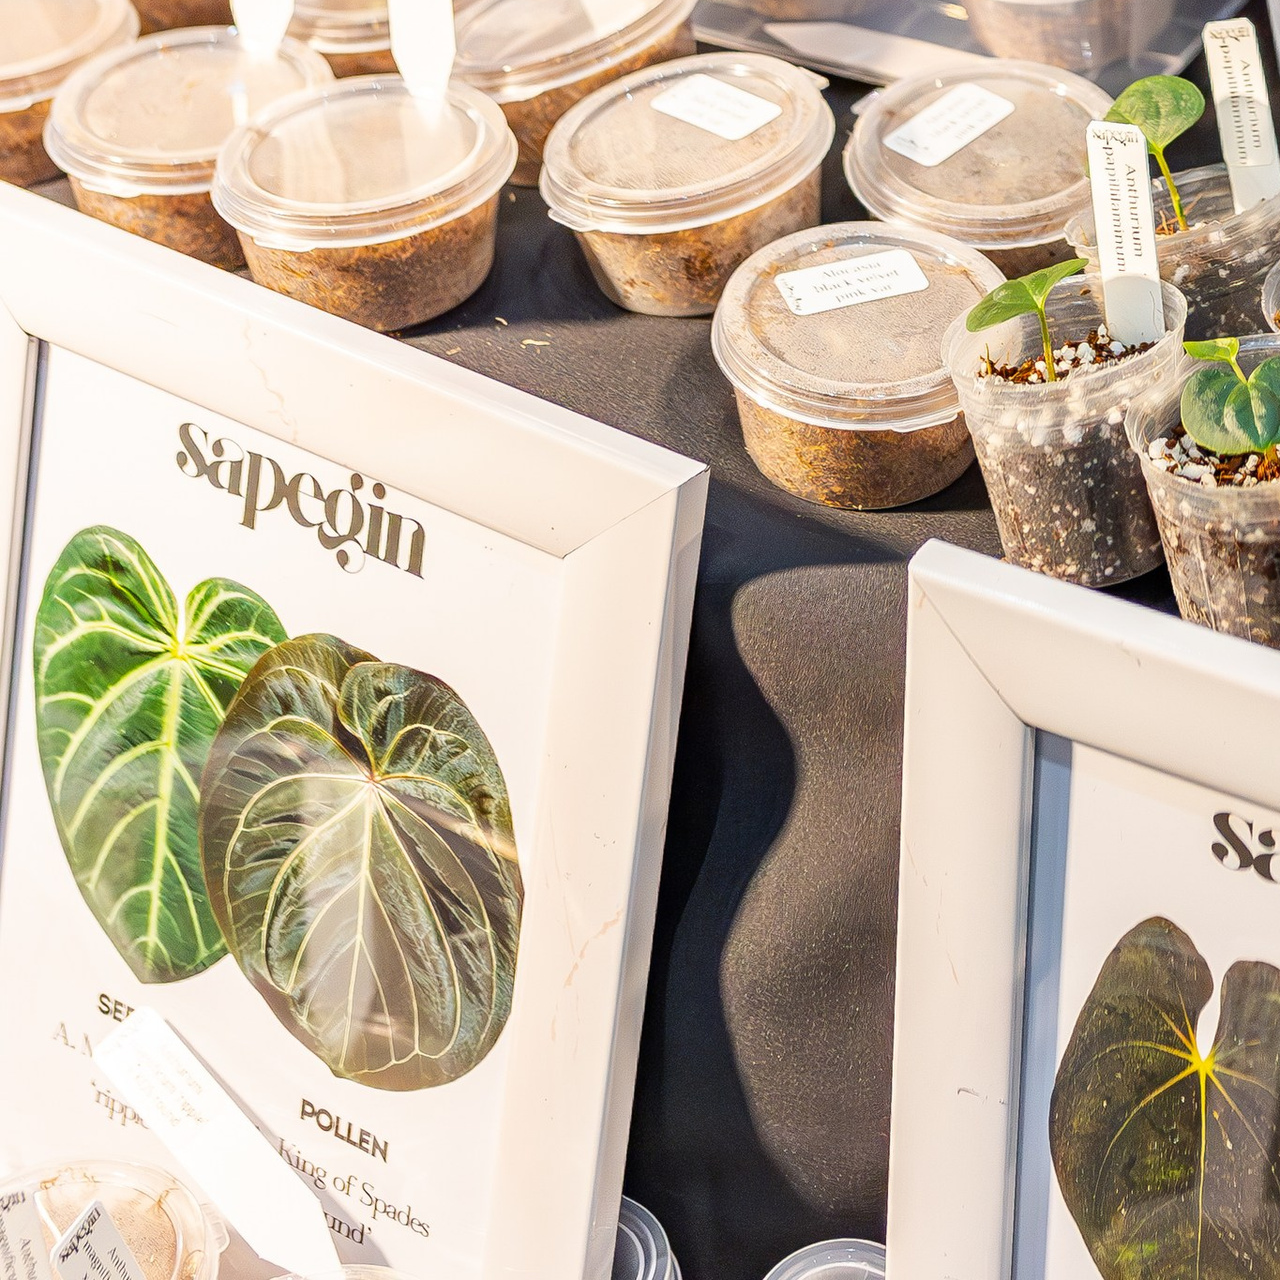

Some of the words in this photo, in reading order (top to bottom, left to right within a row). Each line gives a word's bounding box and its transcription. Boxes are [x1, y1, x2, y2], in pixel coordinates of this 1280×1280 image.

[1124, 163, 1143, 258] Anthurium
[175, 421, 426, 579] sapegin
[300, 1098, 389, 1163] POLLEN
[333, 1174, 358, 1196] of
[360, 1182, 431, 1237] Spades
